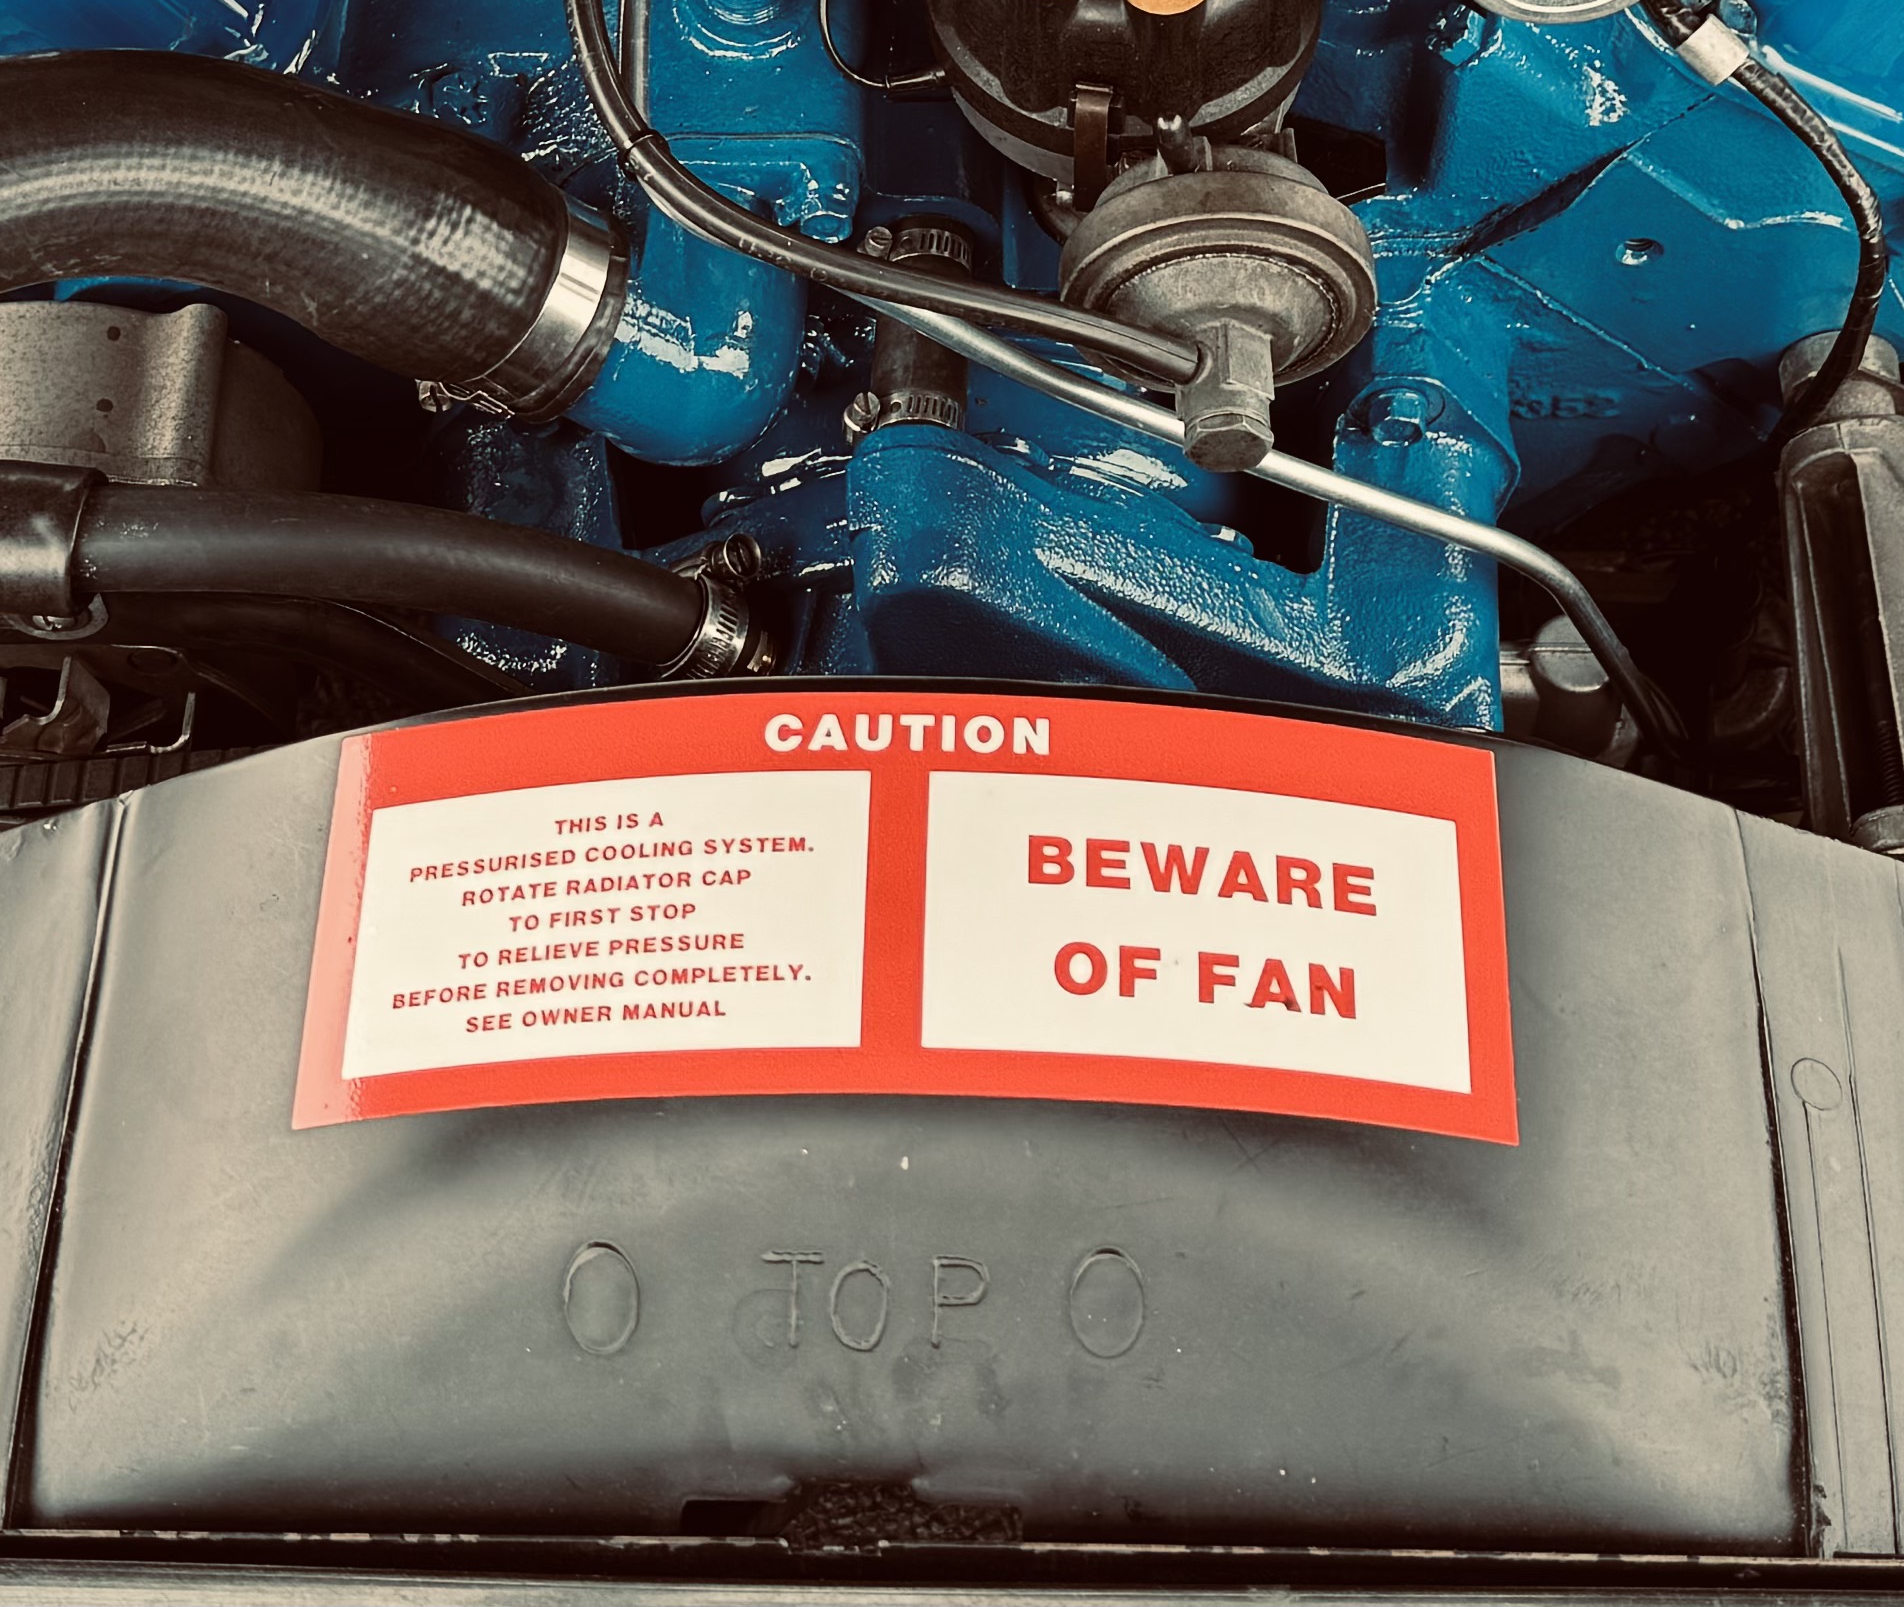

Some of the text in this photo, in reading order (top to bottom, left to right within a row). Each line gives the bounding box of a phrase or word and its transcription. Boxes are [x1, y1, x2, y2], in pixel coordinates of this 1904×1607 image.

[764, 713, 1050, 755] CAUTION
[554, 811, 665, 835] THIS IS A
[409, 835, 815, 883] PRESSURISED COOLING SYSTEM.
[1027, 834, 1378, 917] BEWARE
[461, 868, 752, 907] ROTATE RADIATOR CAP
[509, 902, 697, 932] TO FIRST STOP
[457, 932, 745, 970] TO RELIEVE PRESSURE
[392, 964, 813, 1010] BEFORE REMOVING COMPLETELY.
[1054, 941, 1357, 1020] OF FAN
[465, 1000, 728, 1033] SEE OWNER MANUAL
[760, 1249, 990, 1352] TOP
